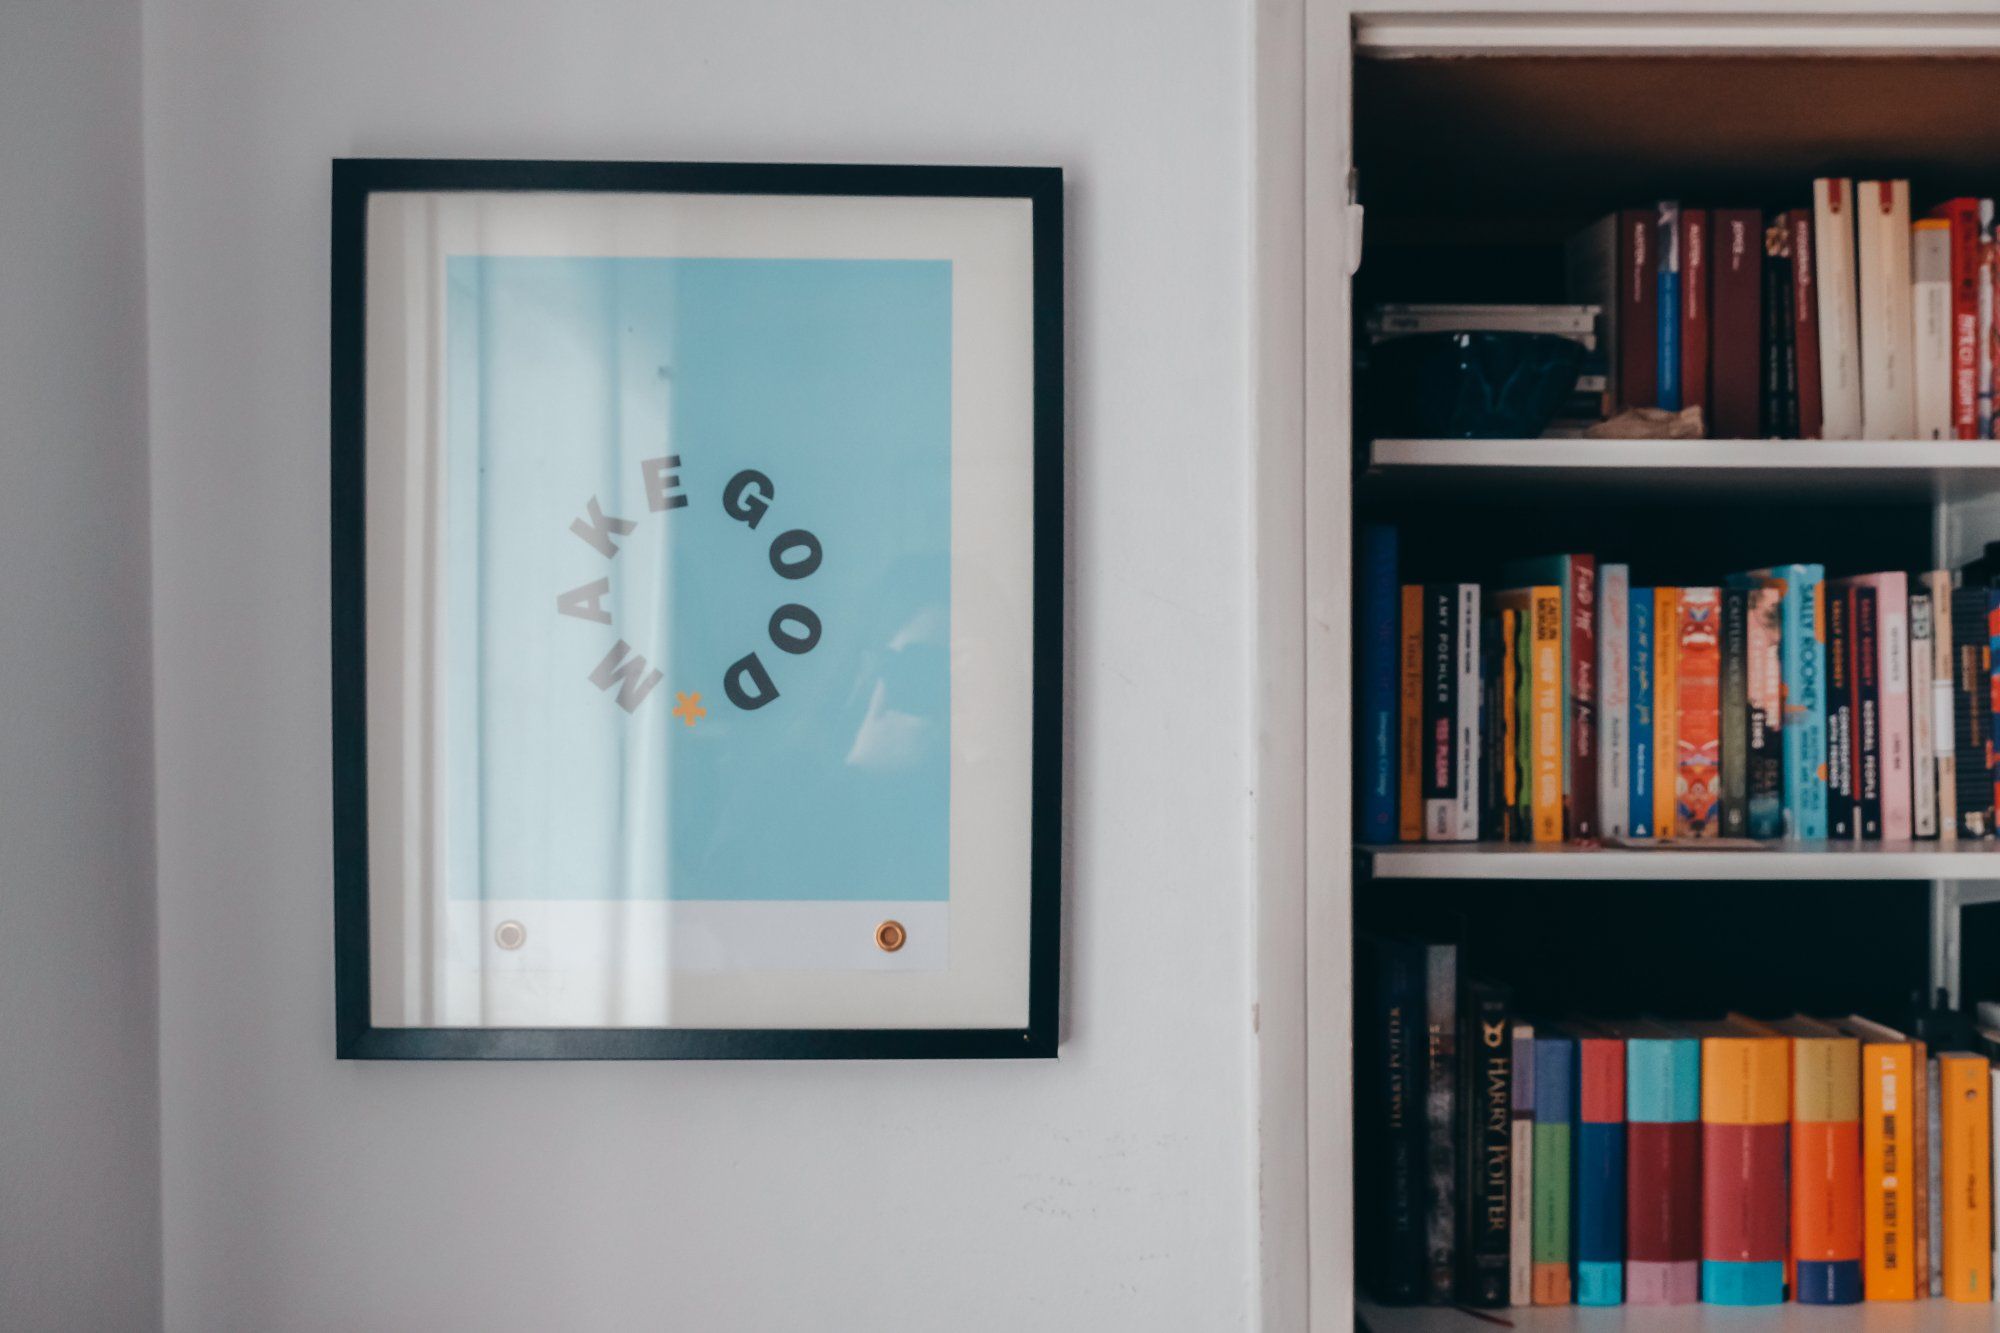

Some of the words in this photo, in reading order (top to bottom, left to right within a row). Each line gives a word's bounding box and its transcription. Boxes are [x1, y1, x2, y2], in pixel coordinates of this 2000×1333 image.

[556, 455, 688, 714] MAKE
[722, 469, 823, 711] GOOD
[1438, 595, 1449, 627] AMY
[1799, 583, 1814, 629] SALLY
[1438, 633, 1449, 702] POEHLER
[1799, 637, 1817, 712] ROONEY
[1540, 688, 1556, 708] TO
[1863, 700, 1874, 751] NORMAL
[1864, 755, 1875, 799] PEOPLE
[1486, 1057, 1509, 1135] HARRY
[1486, 1144, 1508, 1232] POTTER
